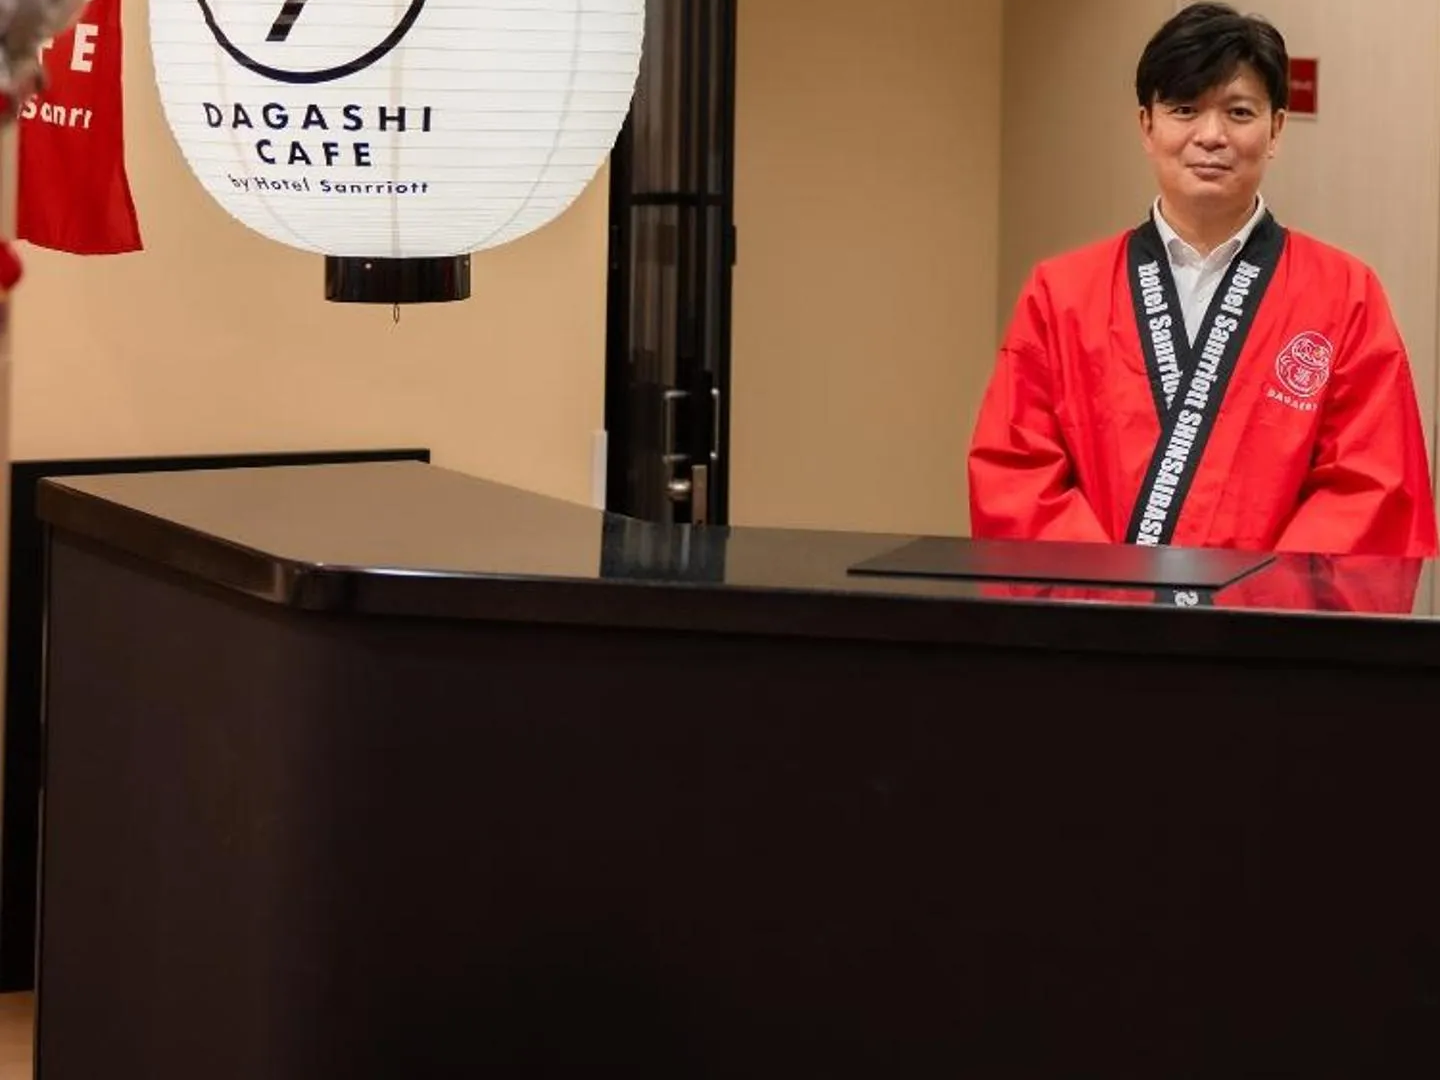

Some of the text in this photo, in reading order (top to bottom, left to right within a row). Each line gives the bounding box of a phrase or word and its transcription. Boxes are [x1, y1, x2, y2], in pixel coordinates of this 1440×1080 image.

[202, 102, 432, 133] DAGASHI
[256, 139, 372, 167] CAFE
[227, 173, 429, 195] by Hotel Sanrriott
[1138, 260, 1169, 315] Hotel
[1220, 260, 1261, 316] Hotel
[1184, 313, 1239, 410] Sanrriott
